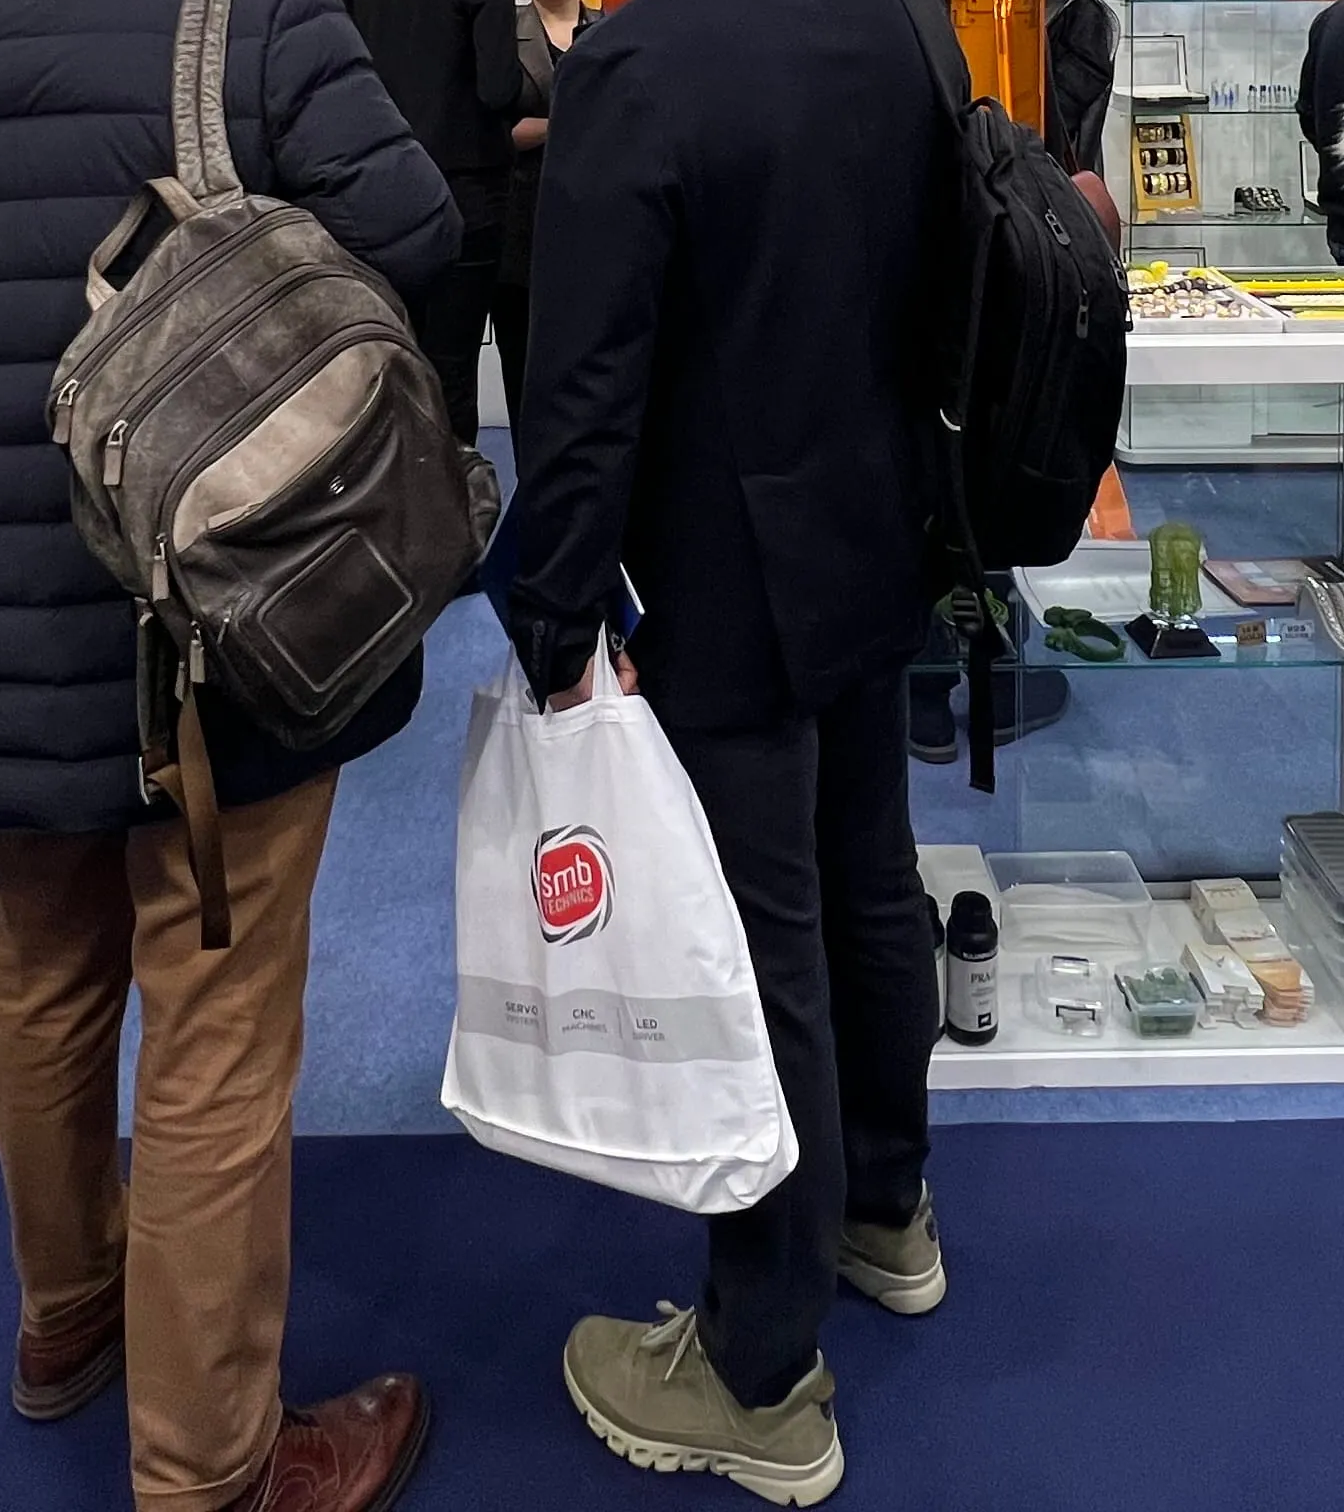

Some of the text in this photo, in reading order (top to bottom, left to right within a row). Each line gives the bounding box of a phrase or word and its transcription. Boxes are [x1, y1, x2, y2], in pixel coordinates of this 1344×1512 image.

[541, 853, 593, 898] smb
[505, 1000, 539, 1016] SERVO
[572, 1008, 596, 1021] CNC
[635, 1017, 658, 1030] LED
